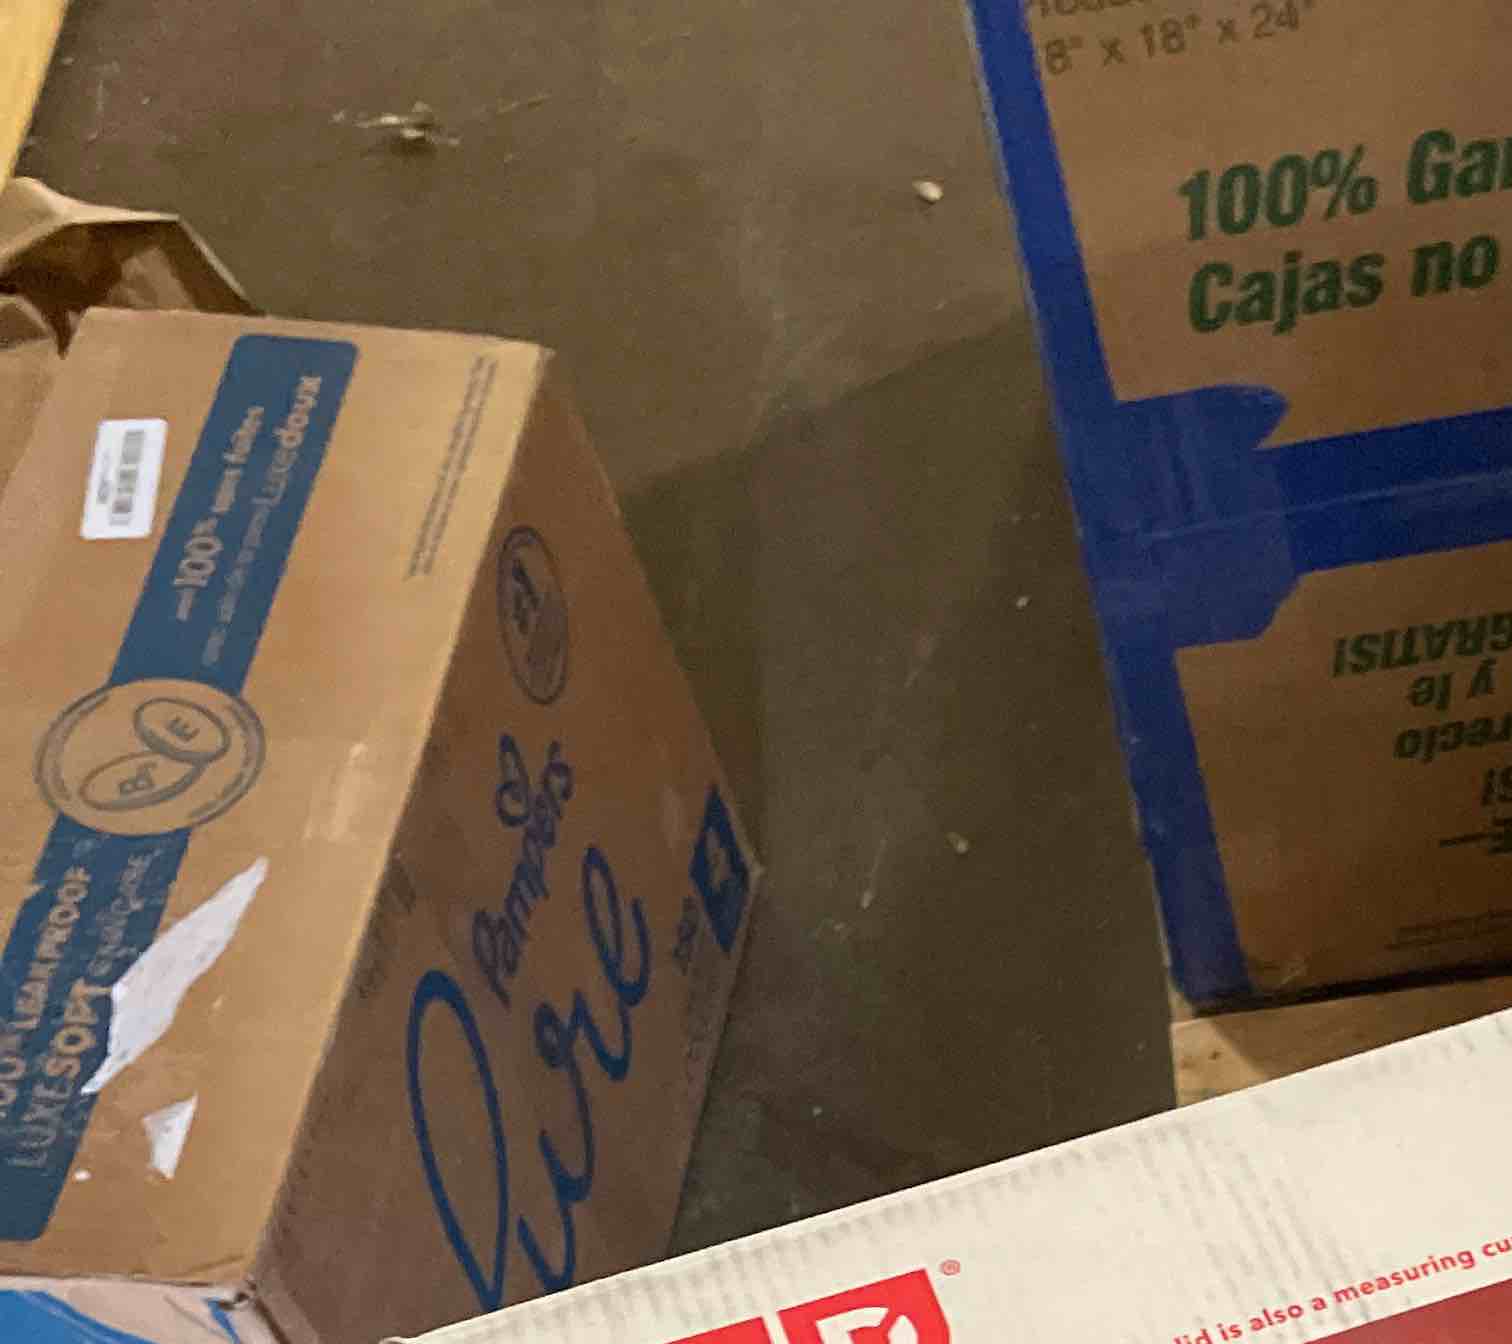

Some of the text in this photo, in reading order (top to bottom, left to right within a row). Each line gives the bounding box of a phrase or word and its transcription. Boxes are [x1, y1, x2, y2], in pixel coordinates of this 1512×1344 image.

[1177, 145, 1380, 241] 100%
[1189, 250, 1386, 336] Cajas
[1409, 233, 1499, 297] no
[1410, 674, 1453, 712] le
[1467, 661, 1497, 702] y
[1249, 1302, 1305, 1334] also
[1312, 1295, 1329, 1313] a
[1332, 1247, 1477, 1306] measuring
